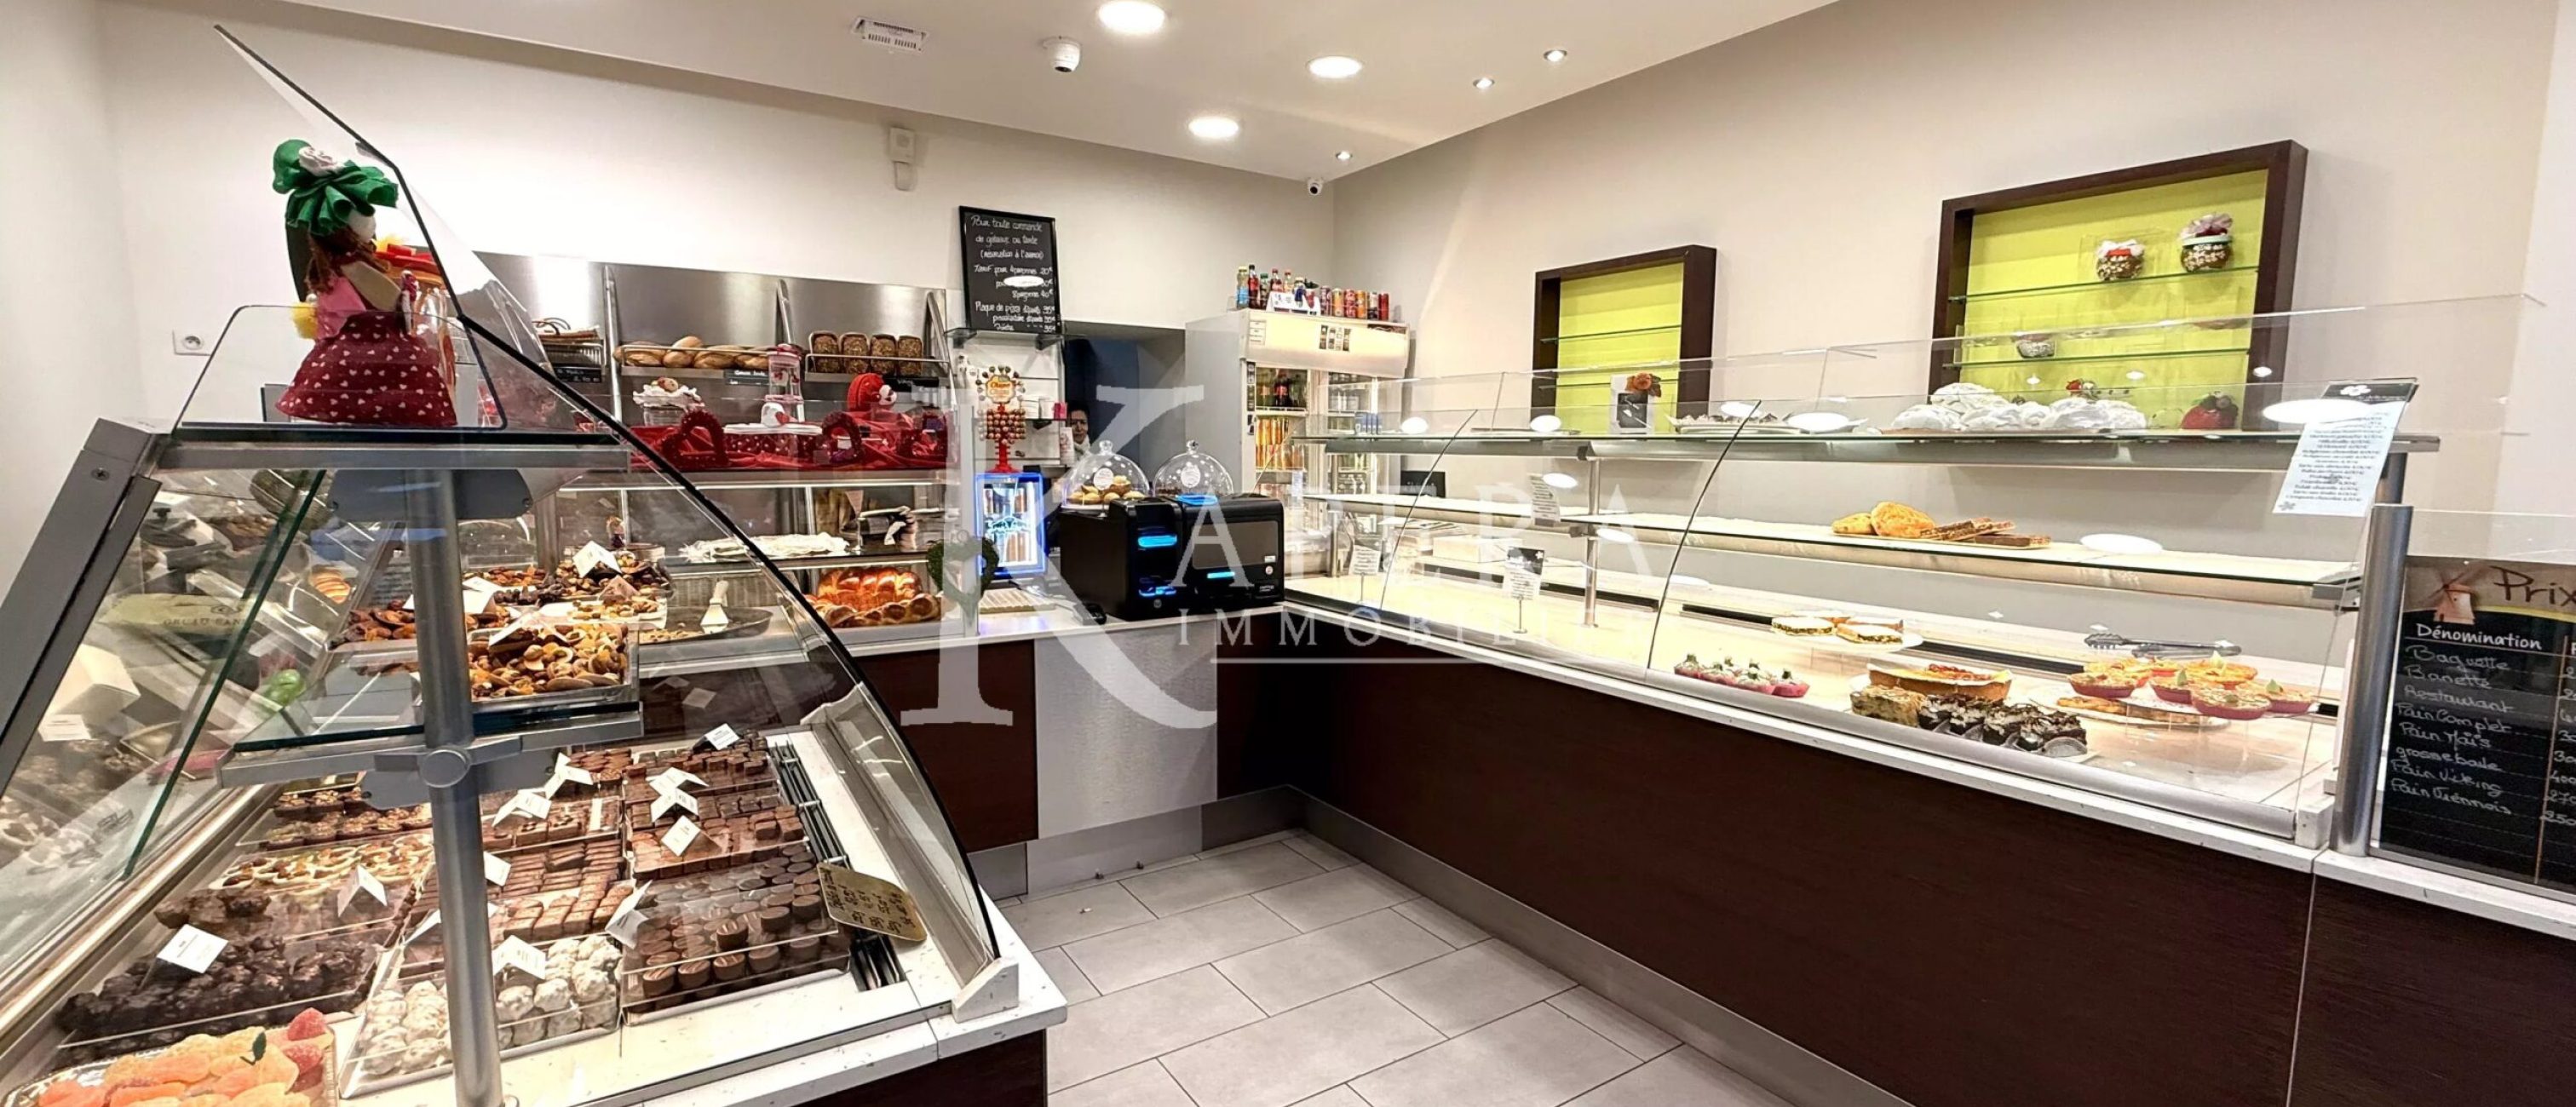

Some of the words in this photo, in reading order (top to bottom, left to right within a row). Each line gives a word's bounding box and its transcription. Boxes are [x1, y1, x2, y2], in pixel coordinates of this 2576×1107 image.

[2490, 565, 2576, 608] Prix
[2416, 623, 2542, 650] Dénomination
[2406, 645, 2510, 672] Baguette
[2404, 664, 2492, 690] Banette
[2404, 685, 2514, 713] Restaurant
[2400, 722, 2441, 742] Pain
[2436, 708, 2512, 734] Complet
[2391, 778, 2430, 798] Pain
